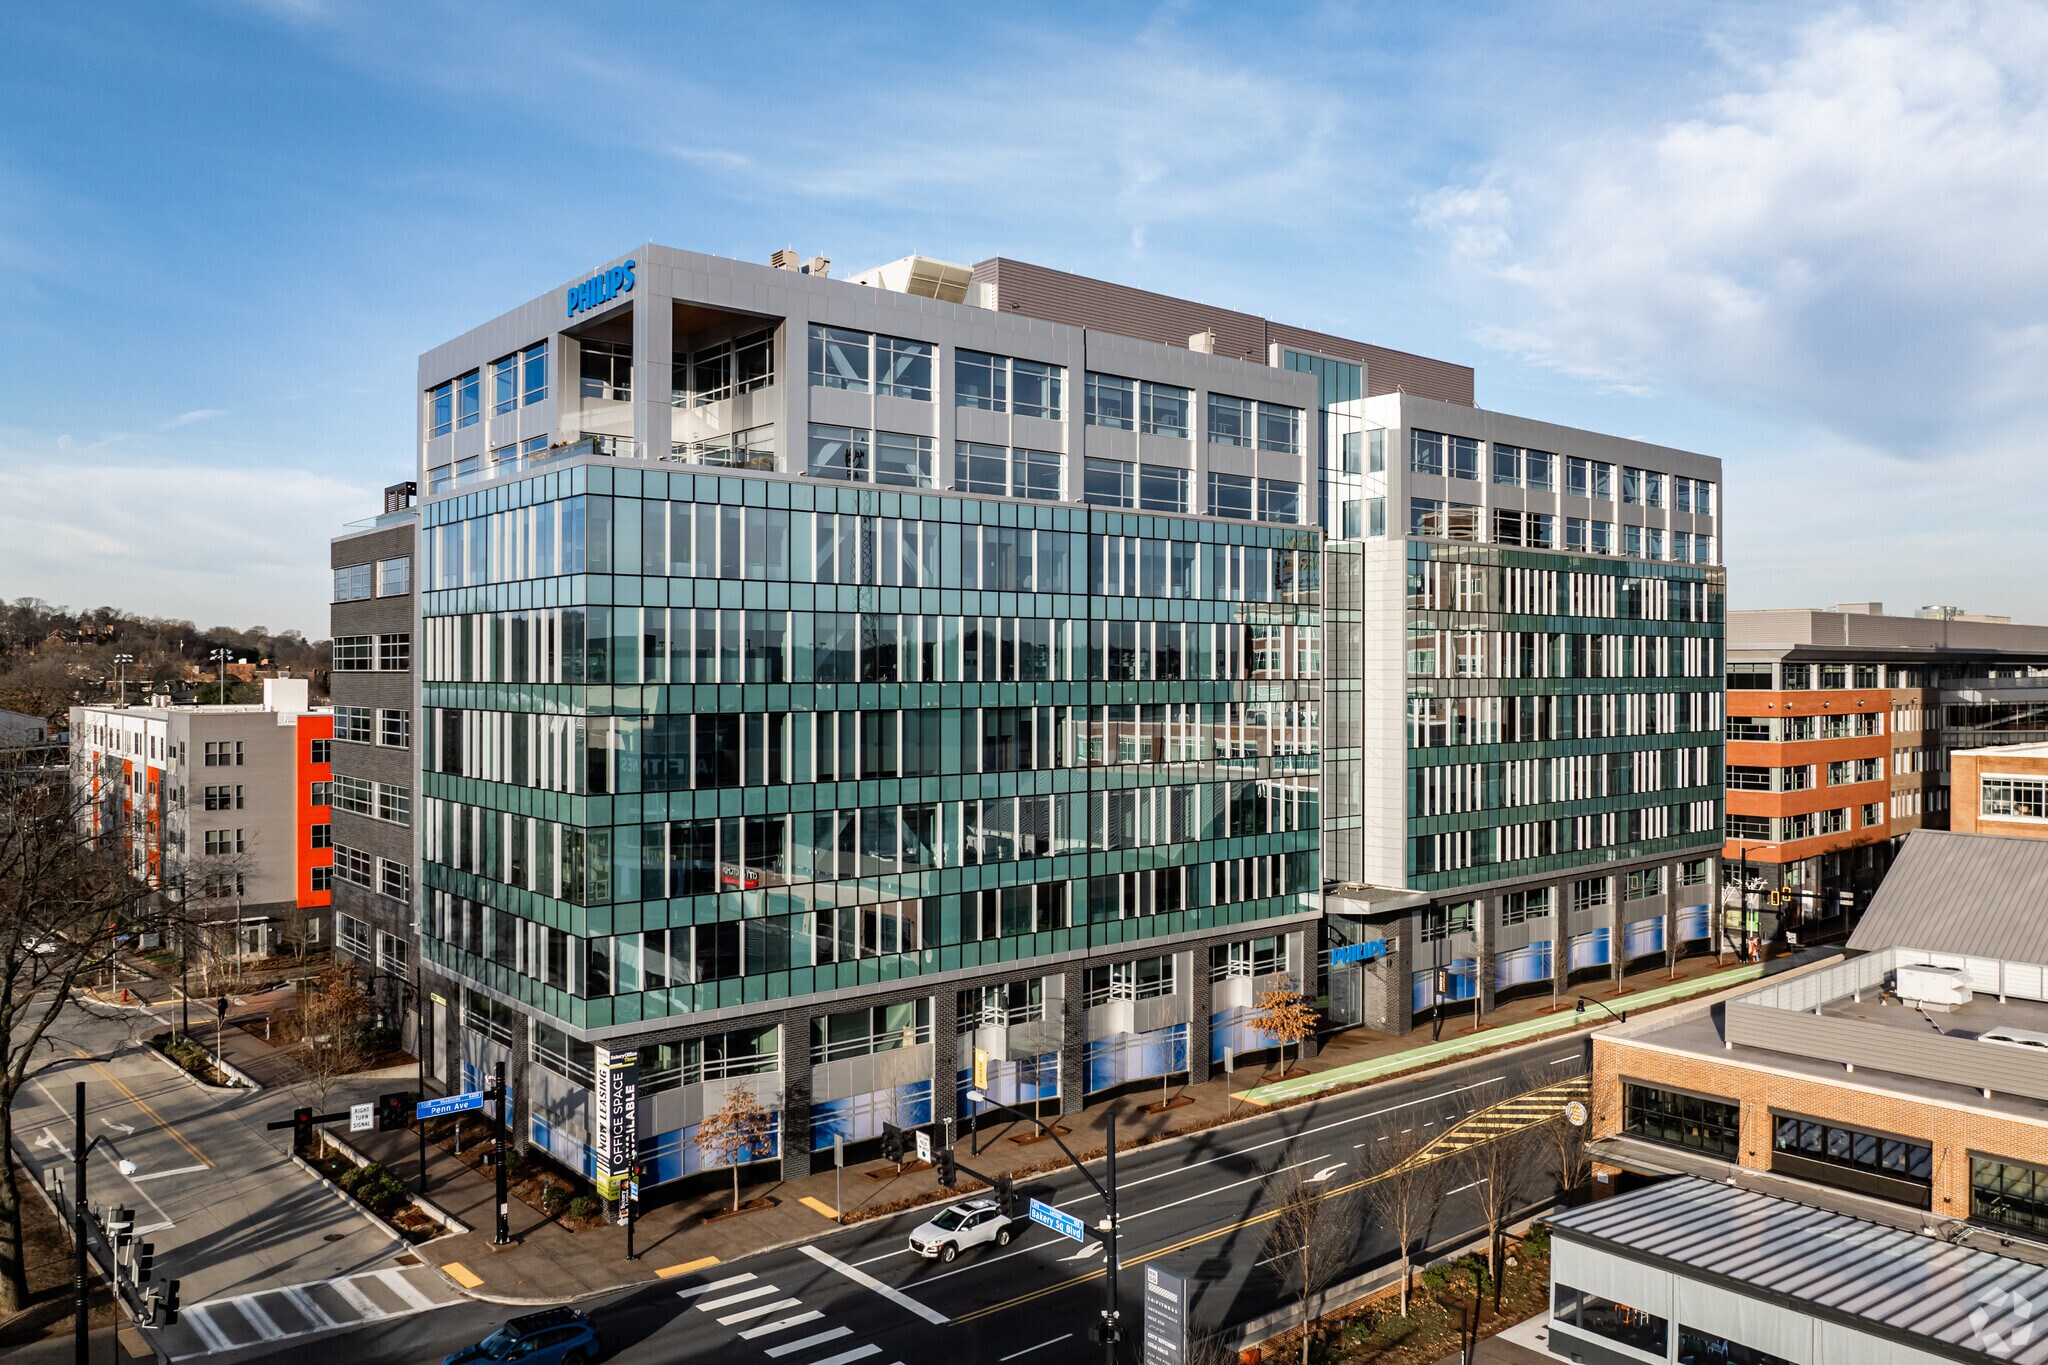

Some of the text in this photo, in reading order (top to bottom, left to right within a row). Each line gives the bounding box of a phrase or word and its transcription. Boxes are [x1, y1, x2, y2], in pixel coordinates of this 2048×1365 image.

[568, 260, 636, 318] PHILIPS
[1331, 939, 1387, 966] PHILIPS
[354, 1106, 370, 1114] RIGHT
[431, 1104, 451, 1114] Penn
[454, 1102, 469, 1110] Ave
[613, 1072, 623, 1164] OFFICE SPACE
[353, 1121, 371, 1129] SIGNAL
[598, 1122, 607, 1152] NOW
[1031, 1209, 1053, 1227] Bakery
[1056, 1220, 1064, 1232] Sq
[1066, 1225, 1080, 1238] Blvd
